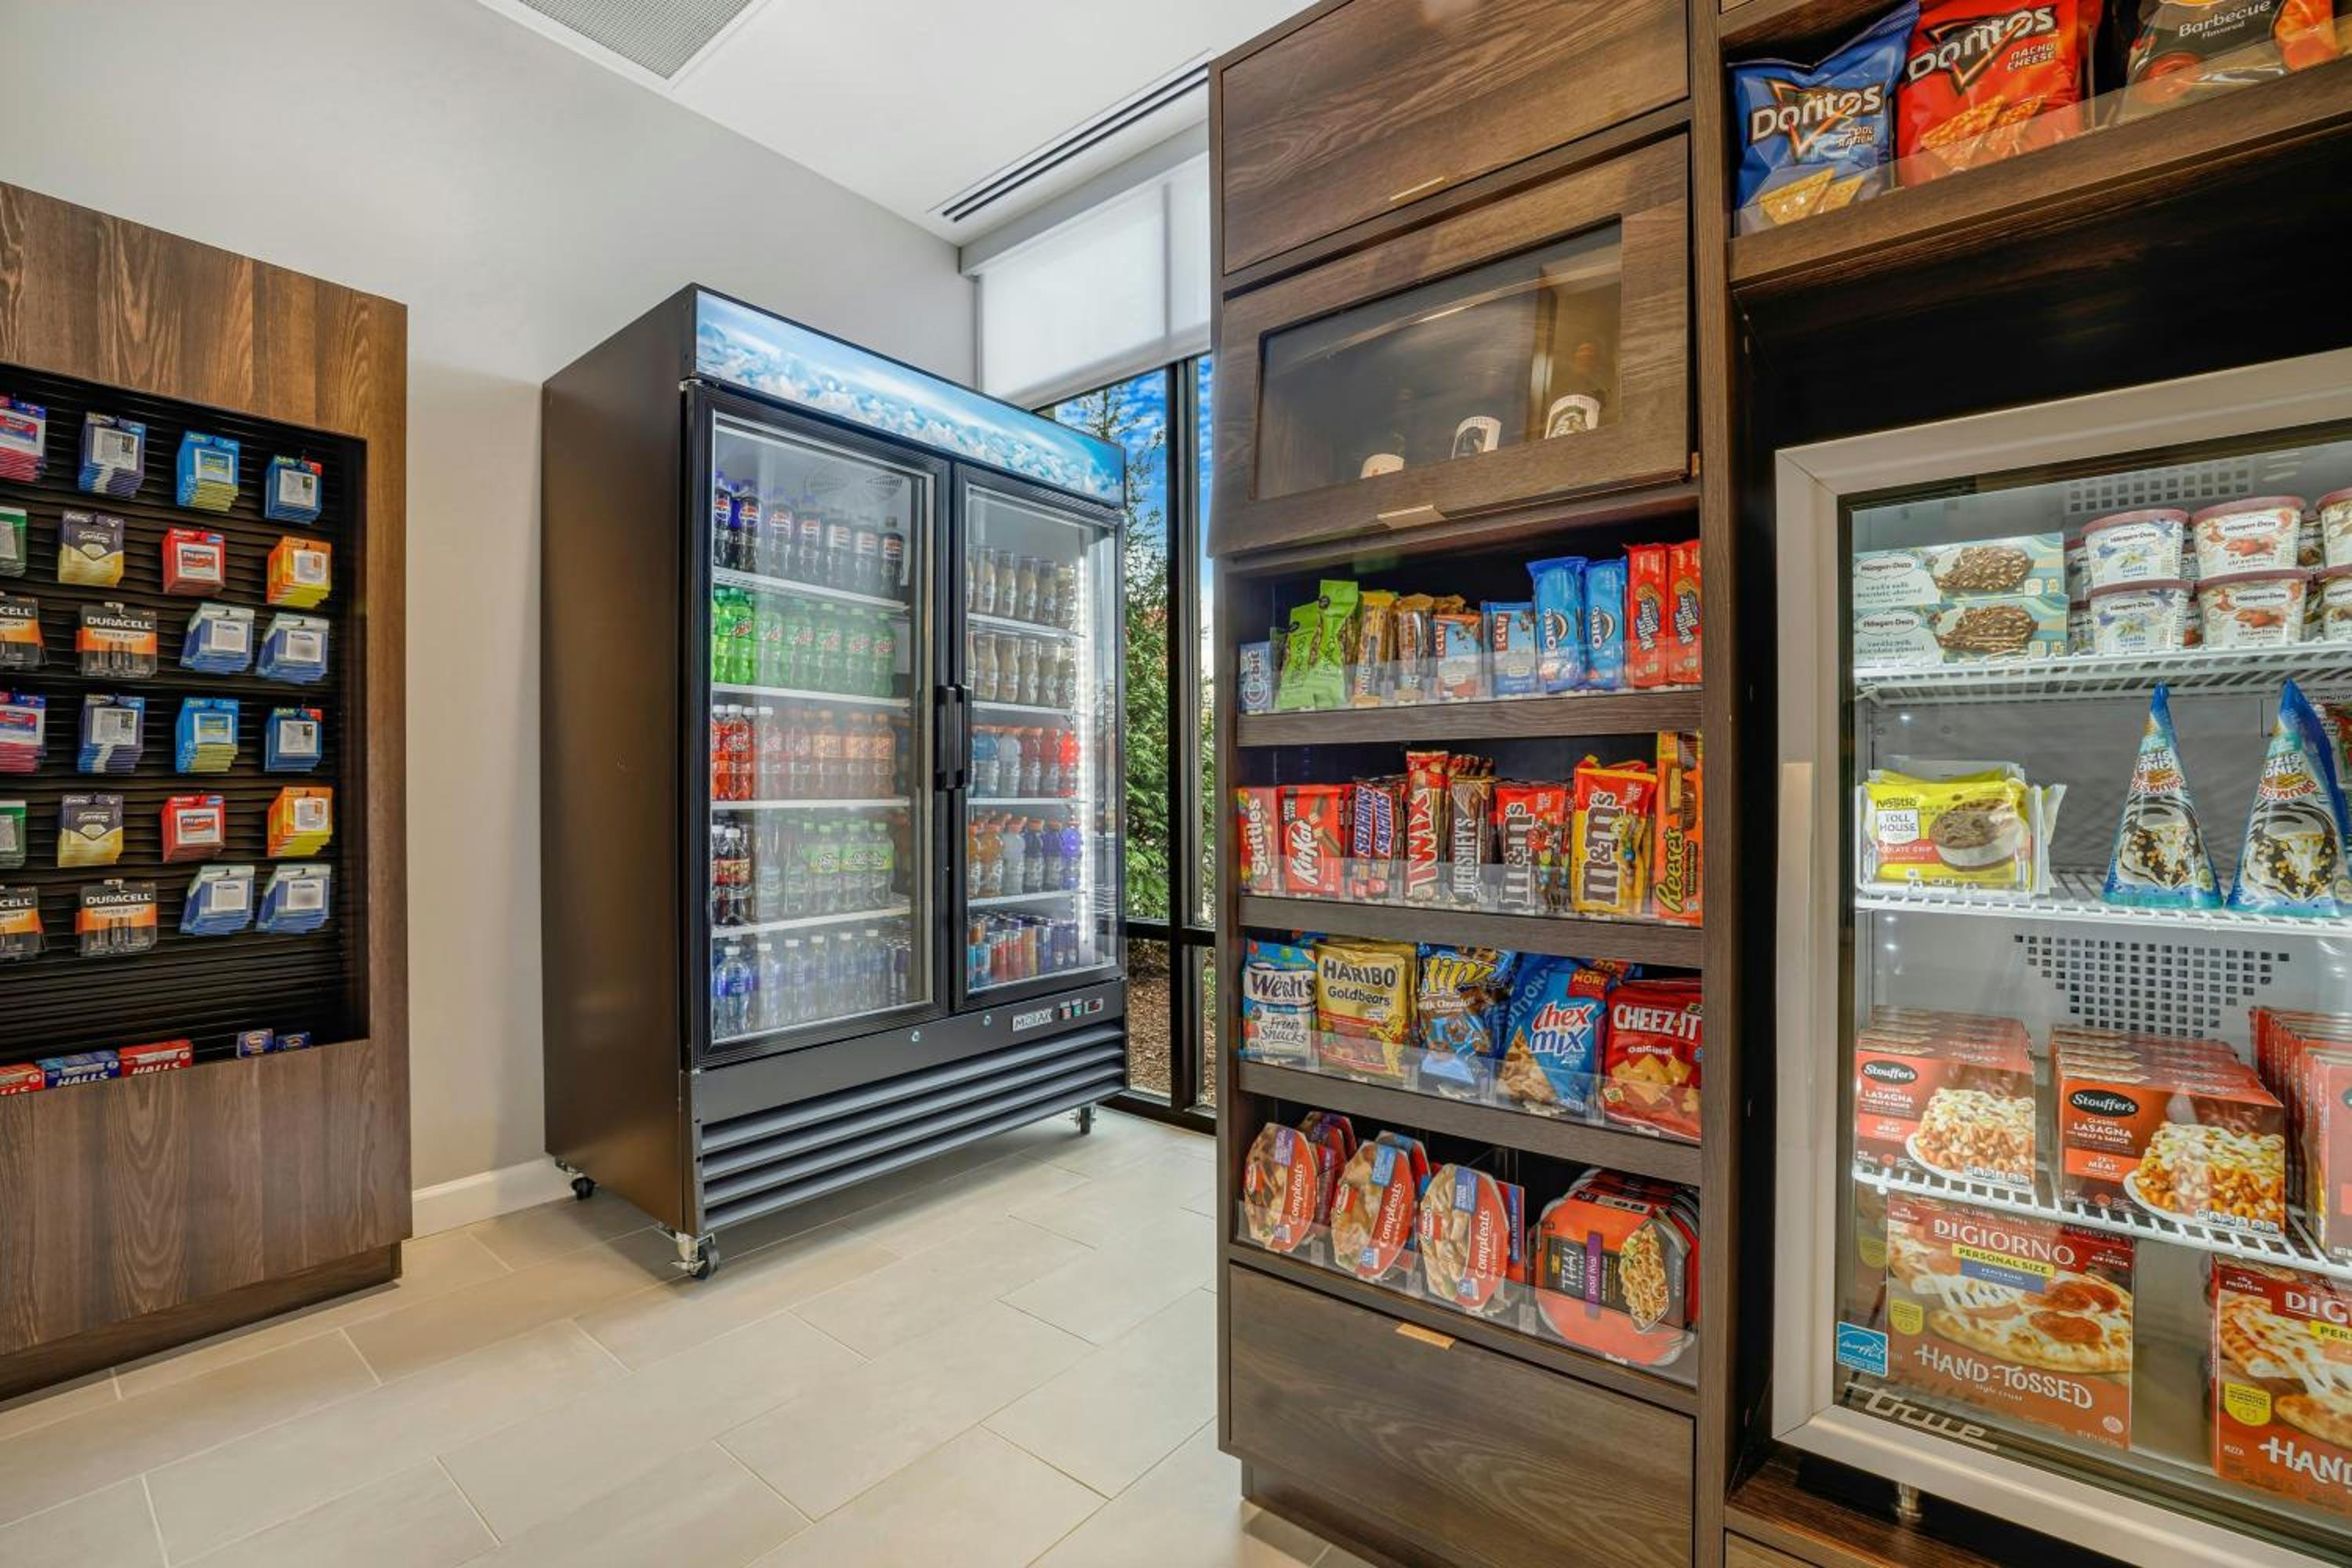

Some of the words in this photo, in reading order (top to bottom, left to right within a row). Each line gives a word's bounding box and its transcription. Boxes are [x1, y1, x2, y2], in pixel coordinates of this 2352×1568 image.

[2180, 1, 2270, 37] Barbecue
[1908, 7, 2056, 81] Doritos
[2006, 52, 2056, 71] CHEESE
[1752, 85, 1881, 142] Doritos
[87, 616, 151, 629] DURACELL
[1436, 624, 1445, 651] CLIF
[1496, 614, 1508, 641] CLIF
[1545, 608, 1556, 650] OREO
[1592, 607, 1602, 649] OREO
[1249, 798, 1268, 876] Skittles
[1406, 790, 1438, 896] TWIX
[1454, 818, 1475, 894] HERSHEY'S
[1656, 828, 1683, 913] Reese's
[86, 893, 151, 905] DURACELL
[1323, 959, 1398, 989] HARIBO
[1327, 985, 1390, 1005] Goldbears
[1260, 1025, 1306, 1043] Snacks
[56, 1072, 110, 1087] HALLS
[1864, 1064, 1915, 1080] Stouffer's
[1865, 1091, 1913, 1103] LASAGNA
[2072, 1093, 2136, 1113] Stouffer's
[2074, 1123, 2133, 1138] LASAGNA
[2088, 1161, 2116, 1171] MEAT
[1289, 1163, 1305, 1225] Compleats
[1379, 1182, 1404, 1248] Compleats
[1475, 1207, 1491, 1279] Compleats
[1562, 1248, 1577, 1289] THAI
[1959, 1249, 2020, 1268] PERSONAL
[2022, 1261, 2048, 1274] SIZE
[2227, 1280, 2263, 1293] PROTEIN
[1914, 1344, 2093, 1409] HAND-TOSSED
[1844, 1381, 1998, 1450] true
